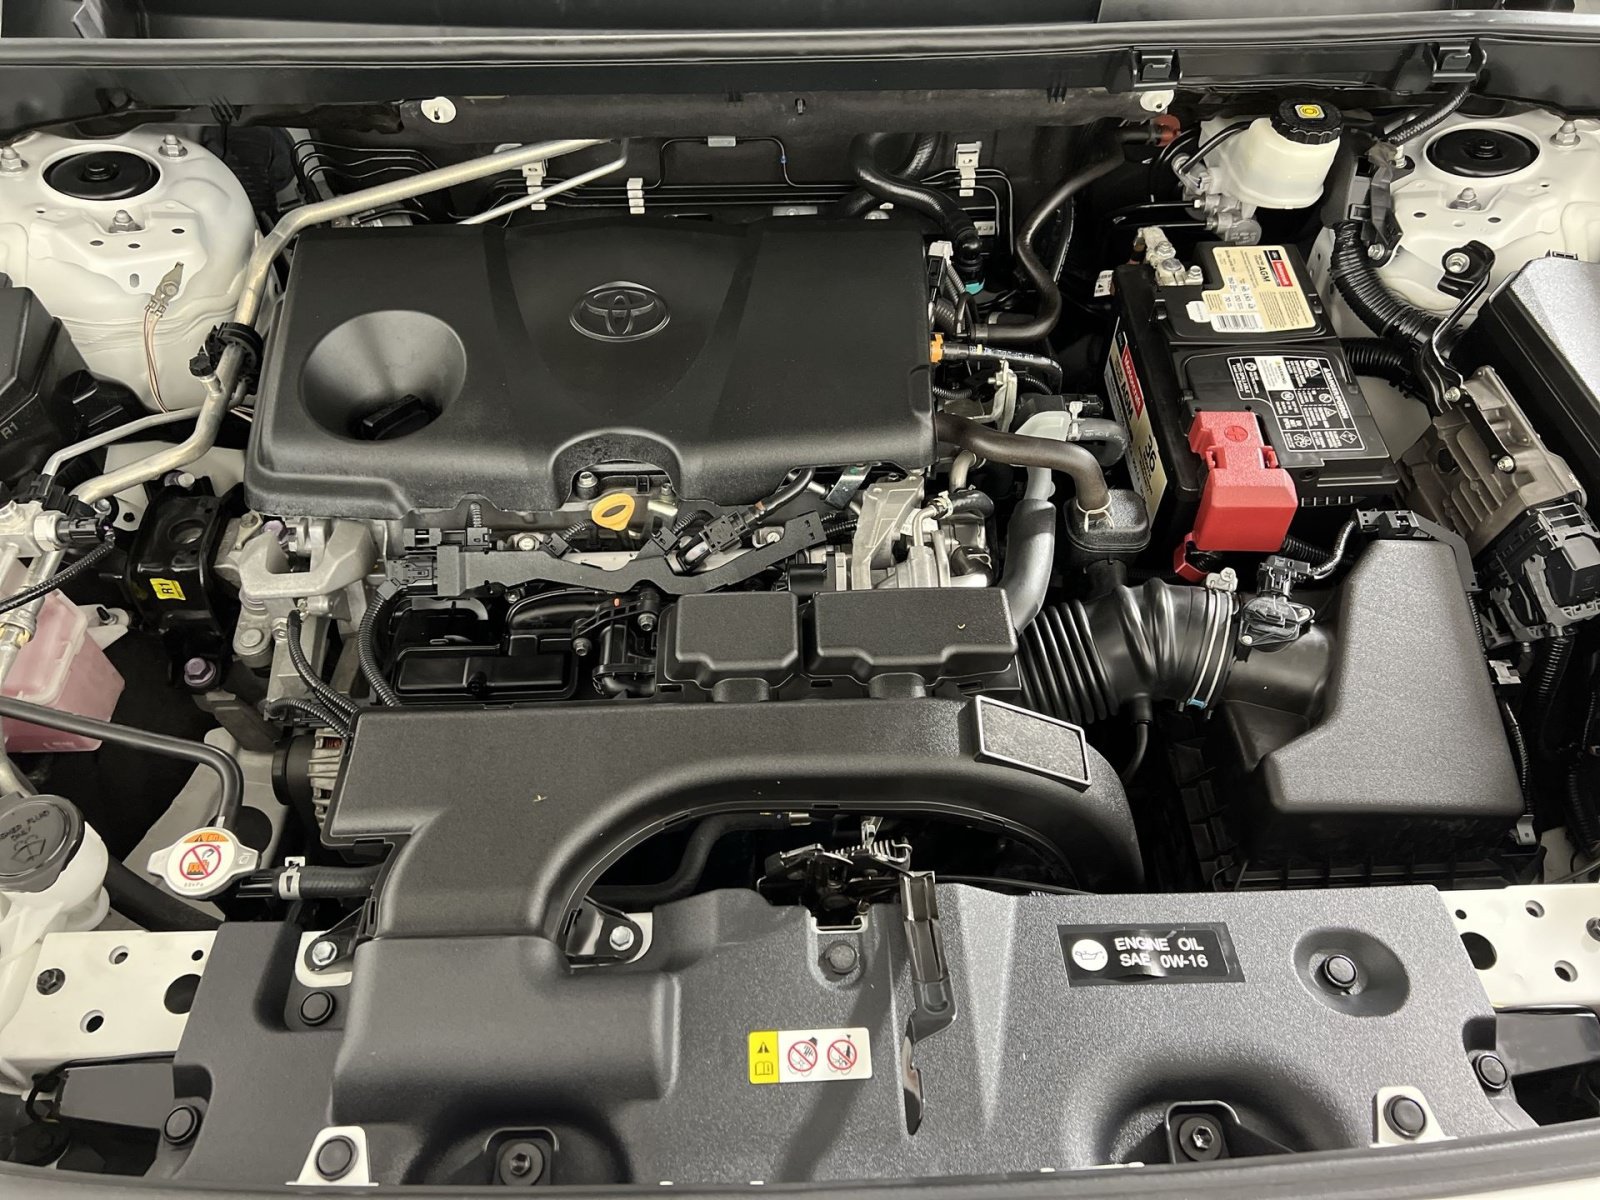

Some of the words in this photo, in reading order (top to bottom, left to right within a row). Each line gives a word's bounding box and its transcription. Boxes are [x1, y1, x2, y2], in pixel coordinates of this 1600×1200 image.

[1259, 266, 1271, 282] AGM
[1121, 381, 1134, 421] AGM
[0, 421, 19, 440] R1
[1145, 434, 1157, 473] 36
[159, 582, 175, 595] R1
[26, 810, 50, 824] FLUID
[1114, 936, 1171, 952] ENGINE
[1177, 936, 1205, 951] OIL
[1119, 952, 1152, 967] SAE
[1160, 953, 1209, 968] 0W-16
